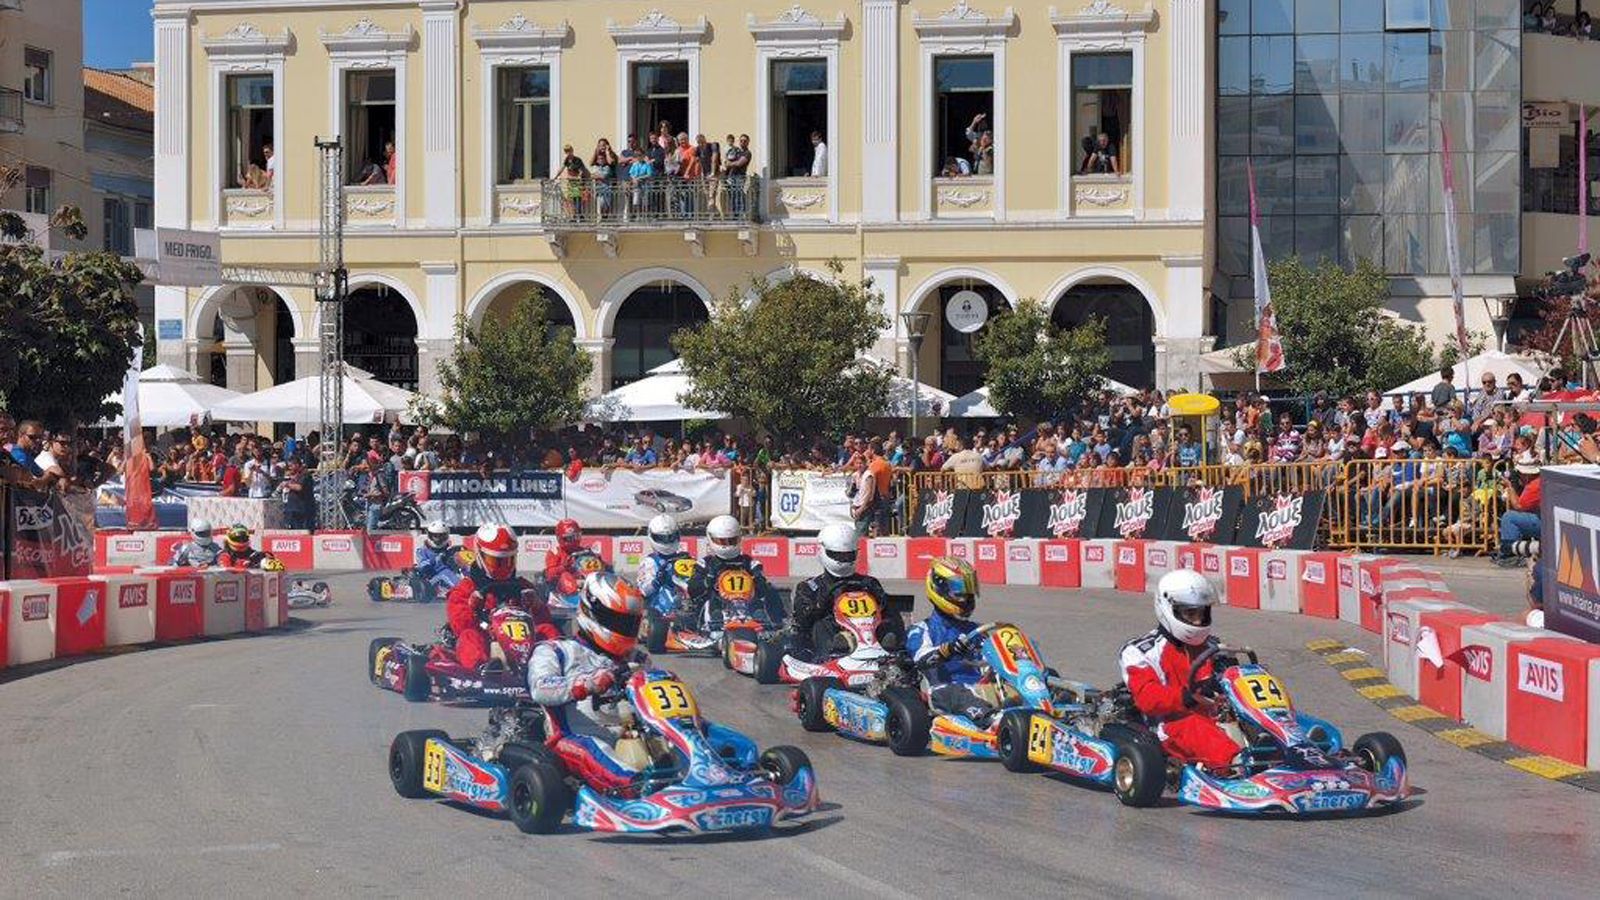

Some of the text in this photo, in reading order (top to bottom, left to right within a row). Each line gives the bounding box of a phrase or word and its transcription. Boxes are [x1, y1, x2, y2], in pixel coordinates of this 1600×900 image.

[185, 243, 212, 260] FRIGO
[431, 478, 558, 494] MINOAN LINES
[780, 492, 800, 512] GP
[275, 541, 297, 550] AVIS
[622, 543, 641, 552] AVIS
[797, 544, 815, 554] AVIS
[174, 583, 193, 601] AVIS
[727, 576, 744, 591] 17
[122, 586, 145, 606] AVIS
[847, 599, 869, 614] 91
[507, 622, 527, 638] 13
[1526, 662, 1558, 693] AVIS
[652, 685, 688, 709] 33
[1247, 679, 1282, 702] 24
[1031, 723, 1048, 753] 24
[427, 751, 441, 785] 33
